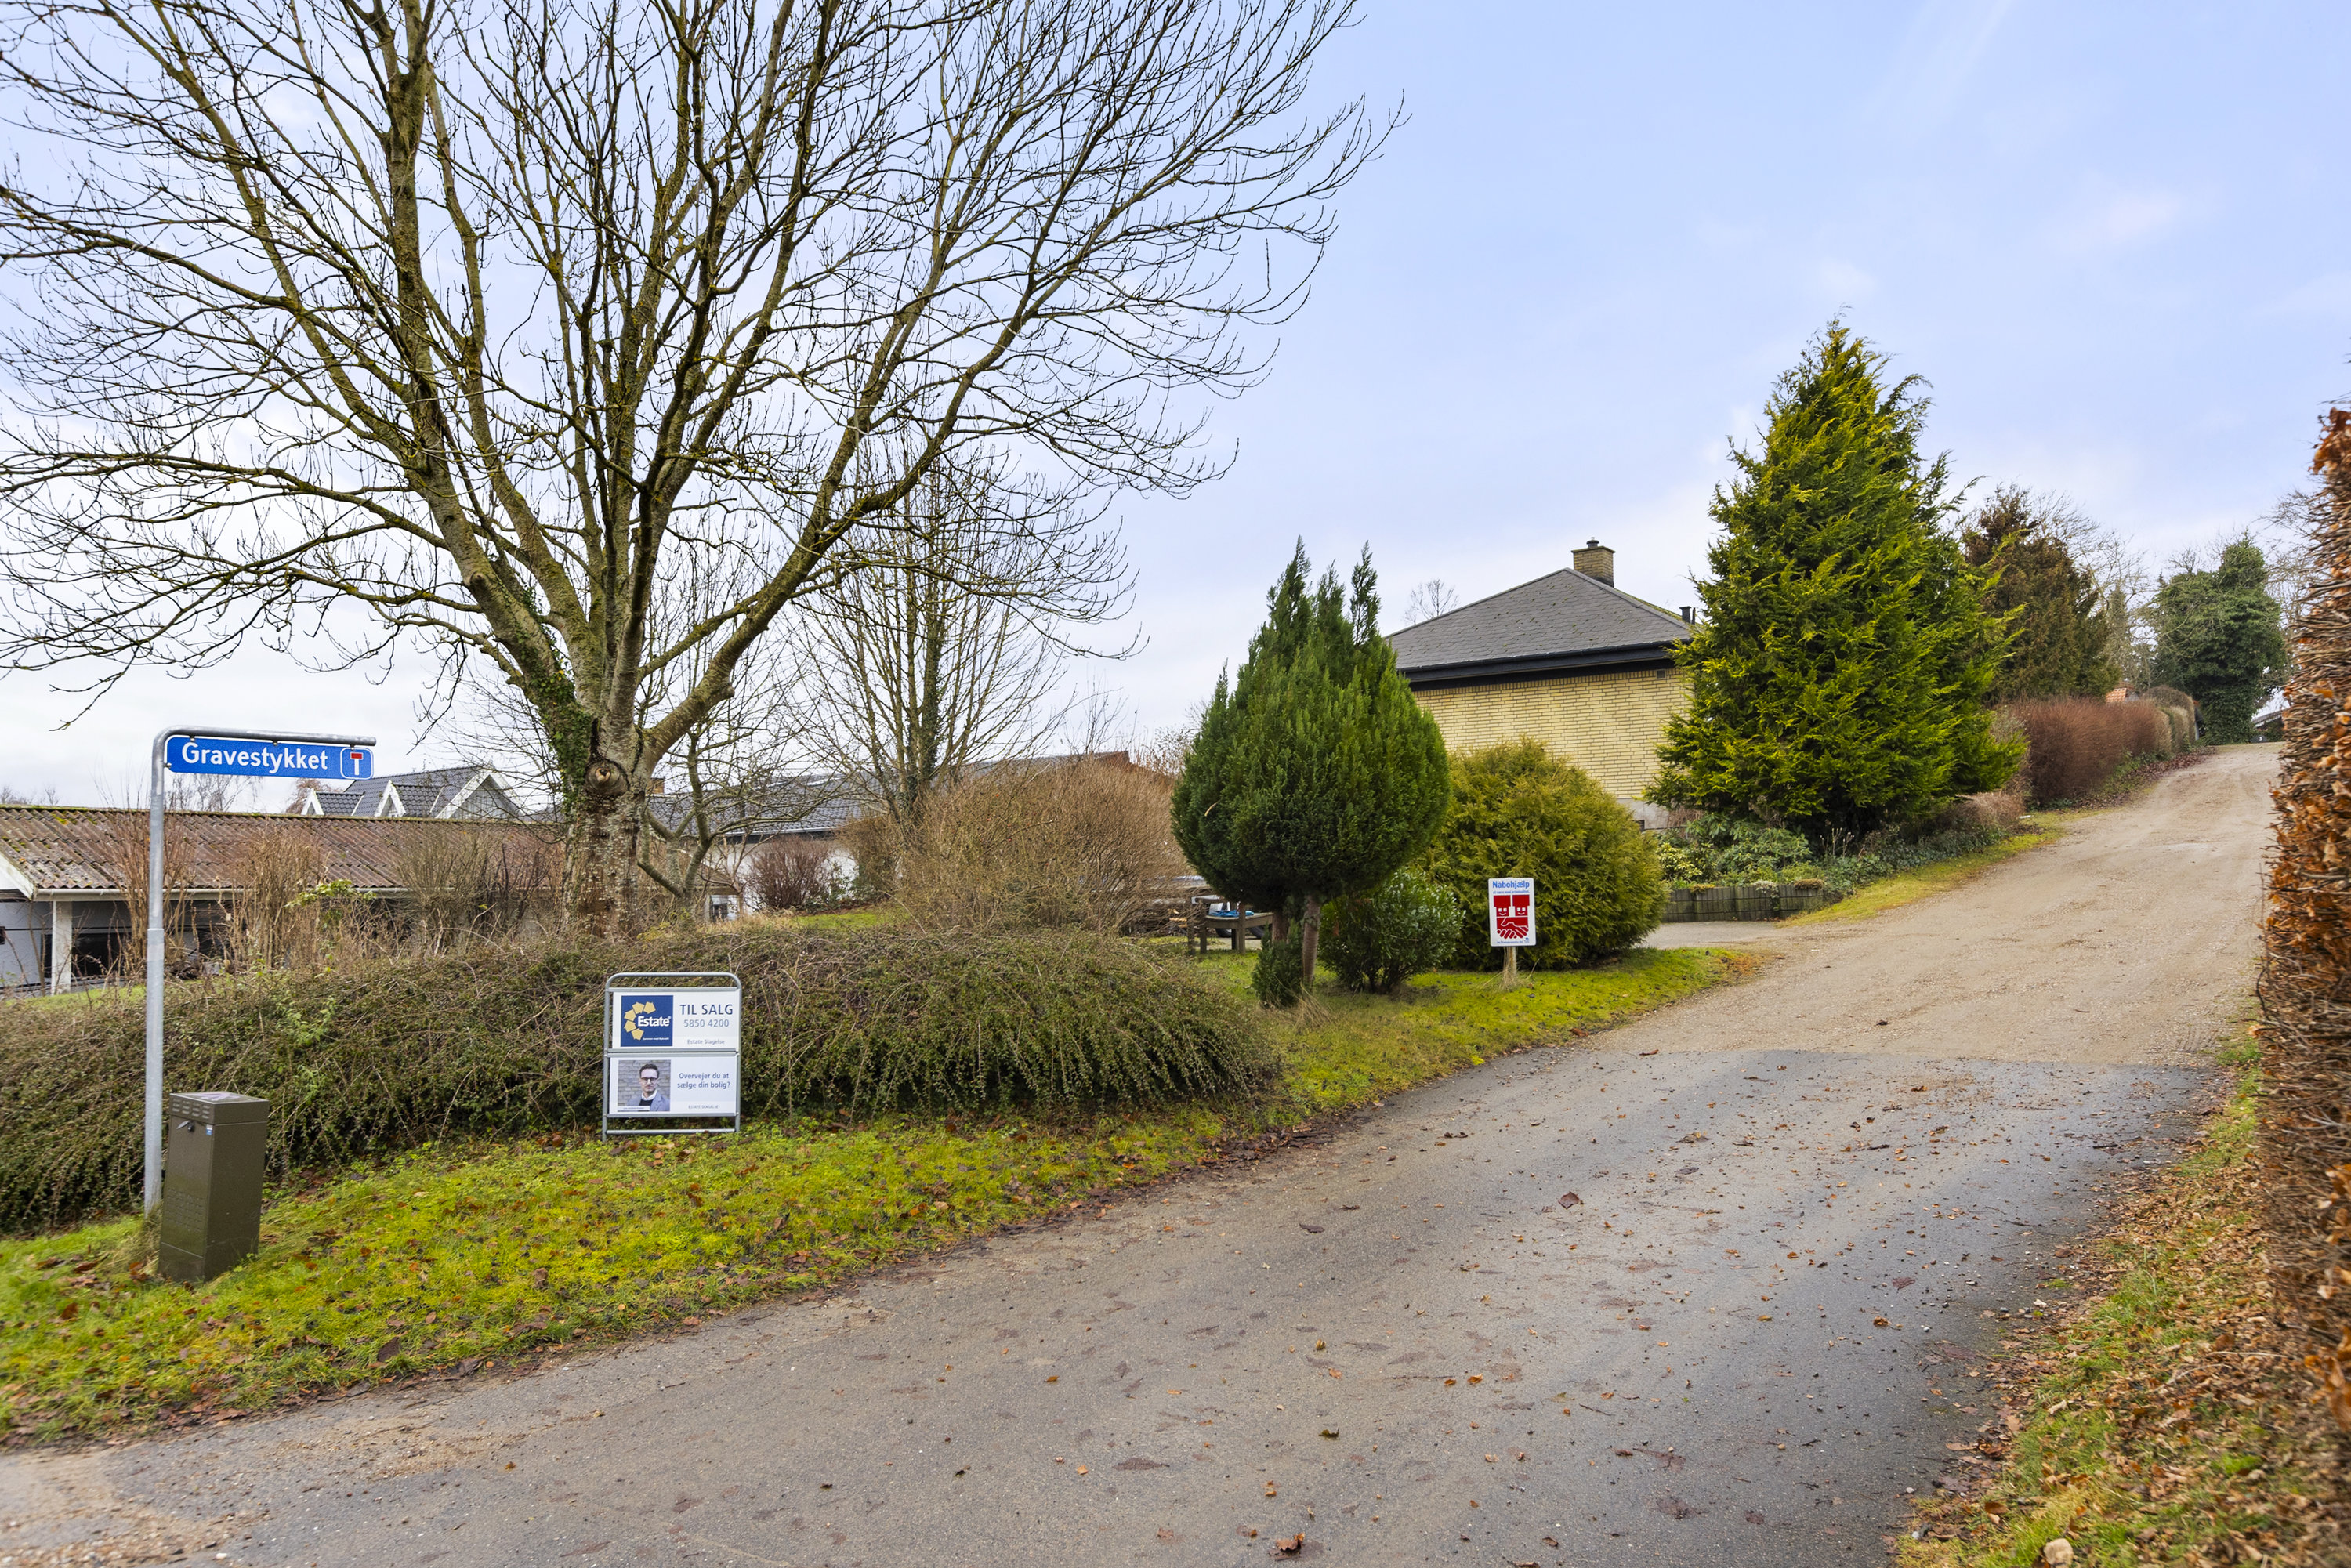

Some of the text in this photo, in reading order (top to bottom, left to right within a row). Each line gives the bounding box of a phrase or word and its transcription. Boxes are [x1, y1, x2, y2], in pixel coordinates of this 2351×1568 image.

[182, 741, 328, 774] Gravestykket
[1492, 880, 1531, 889] Nabohjælp
[679, 1004, 734, 1015] TIL SALG
[637, 1016, 670, 1027] Estate
[679, 1072, 711, 1081] Overvejer
